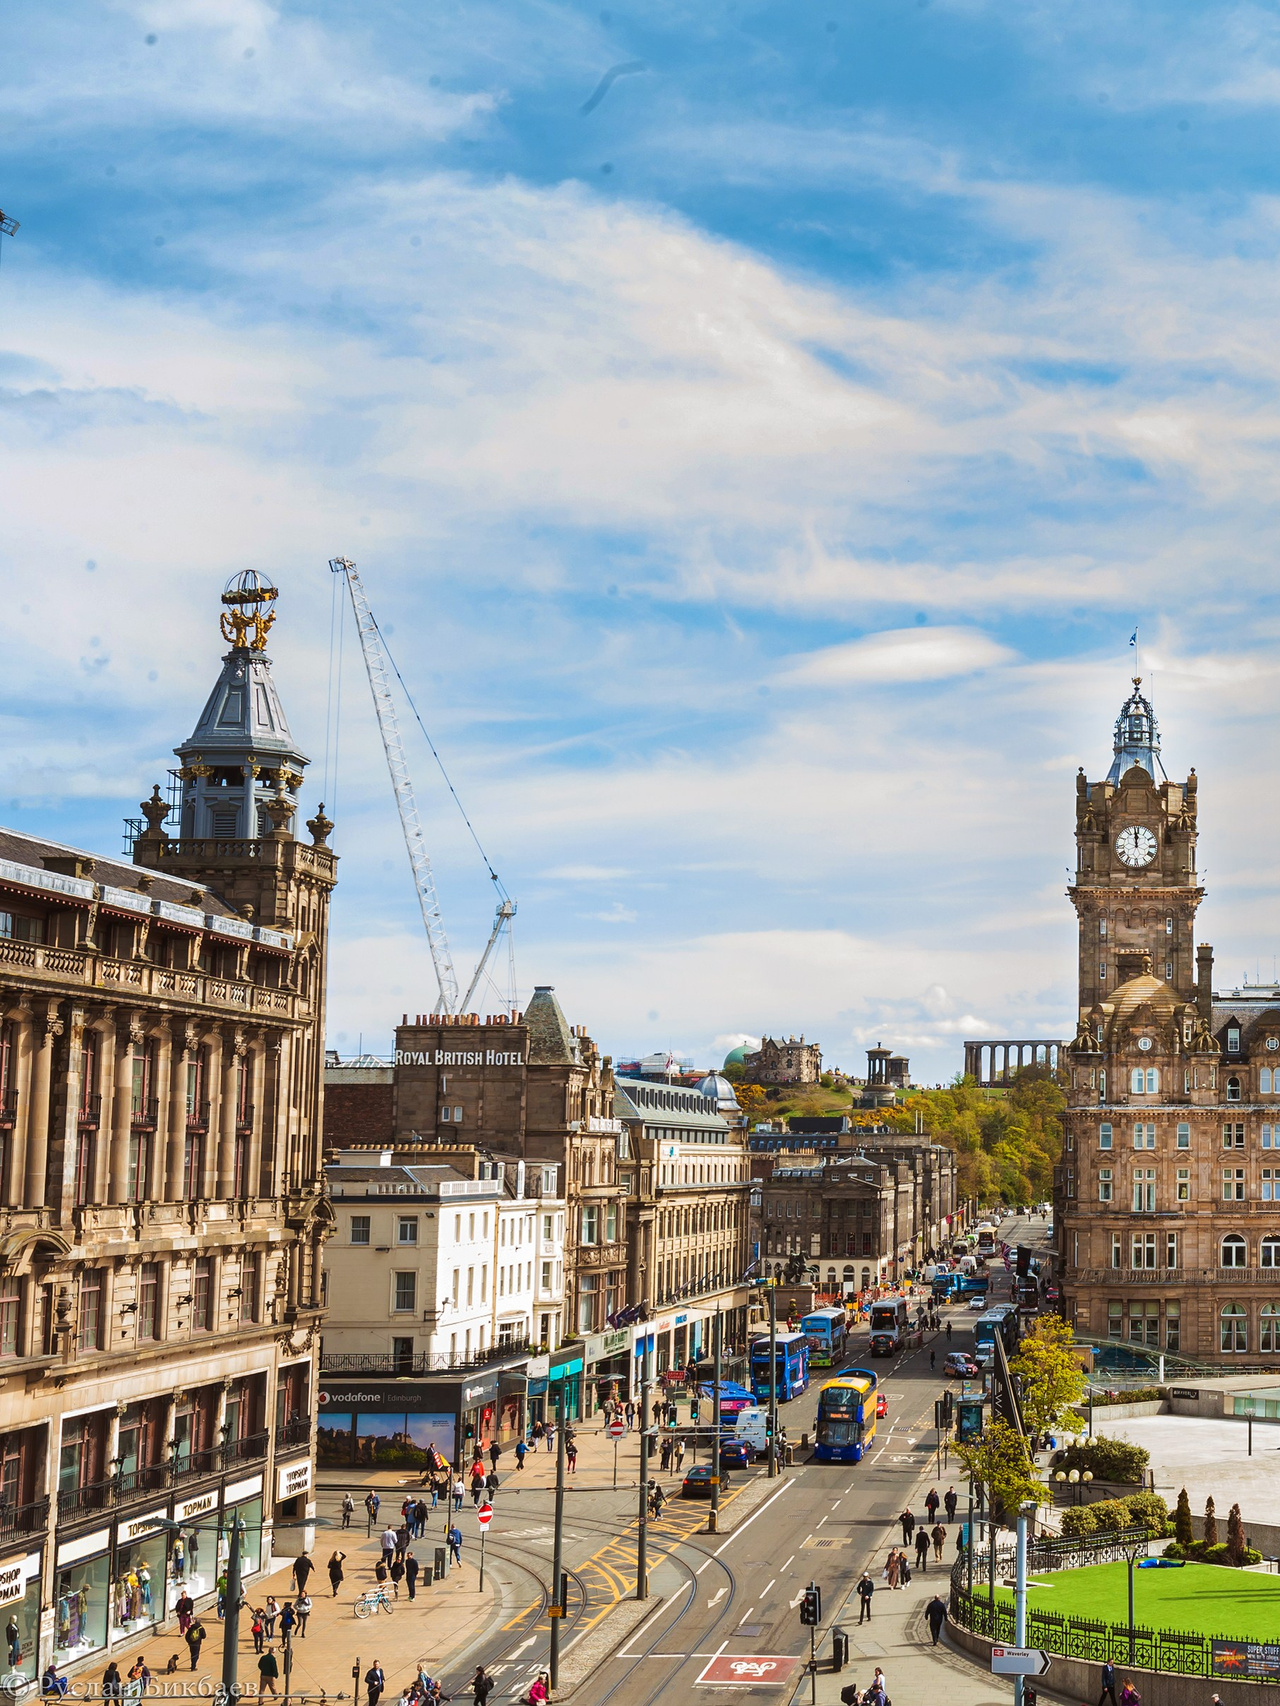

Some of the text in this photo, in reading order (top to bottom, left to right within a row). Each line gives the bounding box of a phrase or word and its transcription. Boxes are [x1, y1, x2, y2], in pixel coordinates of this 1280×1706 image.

[395, 1049, 525, 1065] ROYAL BRITISH HOTEL
[332, 1392, 422, 1404] vodafone Edinburgh
[183, 1496, 212, 1517] TOPMAN
[1247, 1645, 1280, 1657] SUPER STUFF
